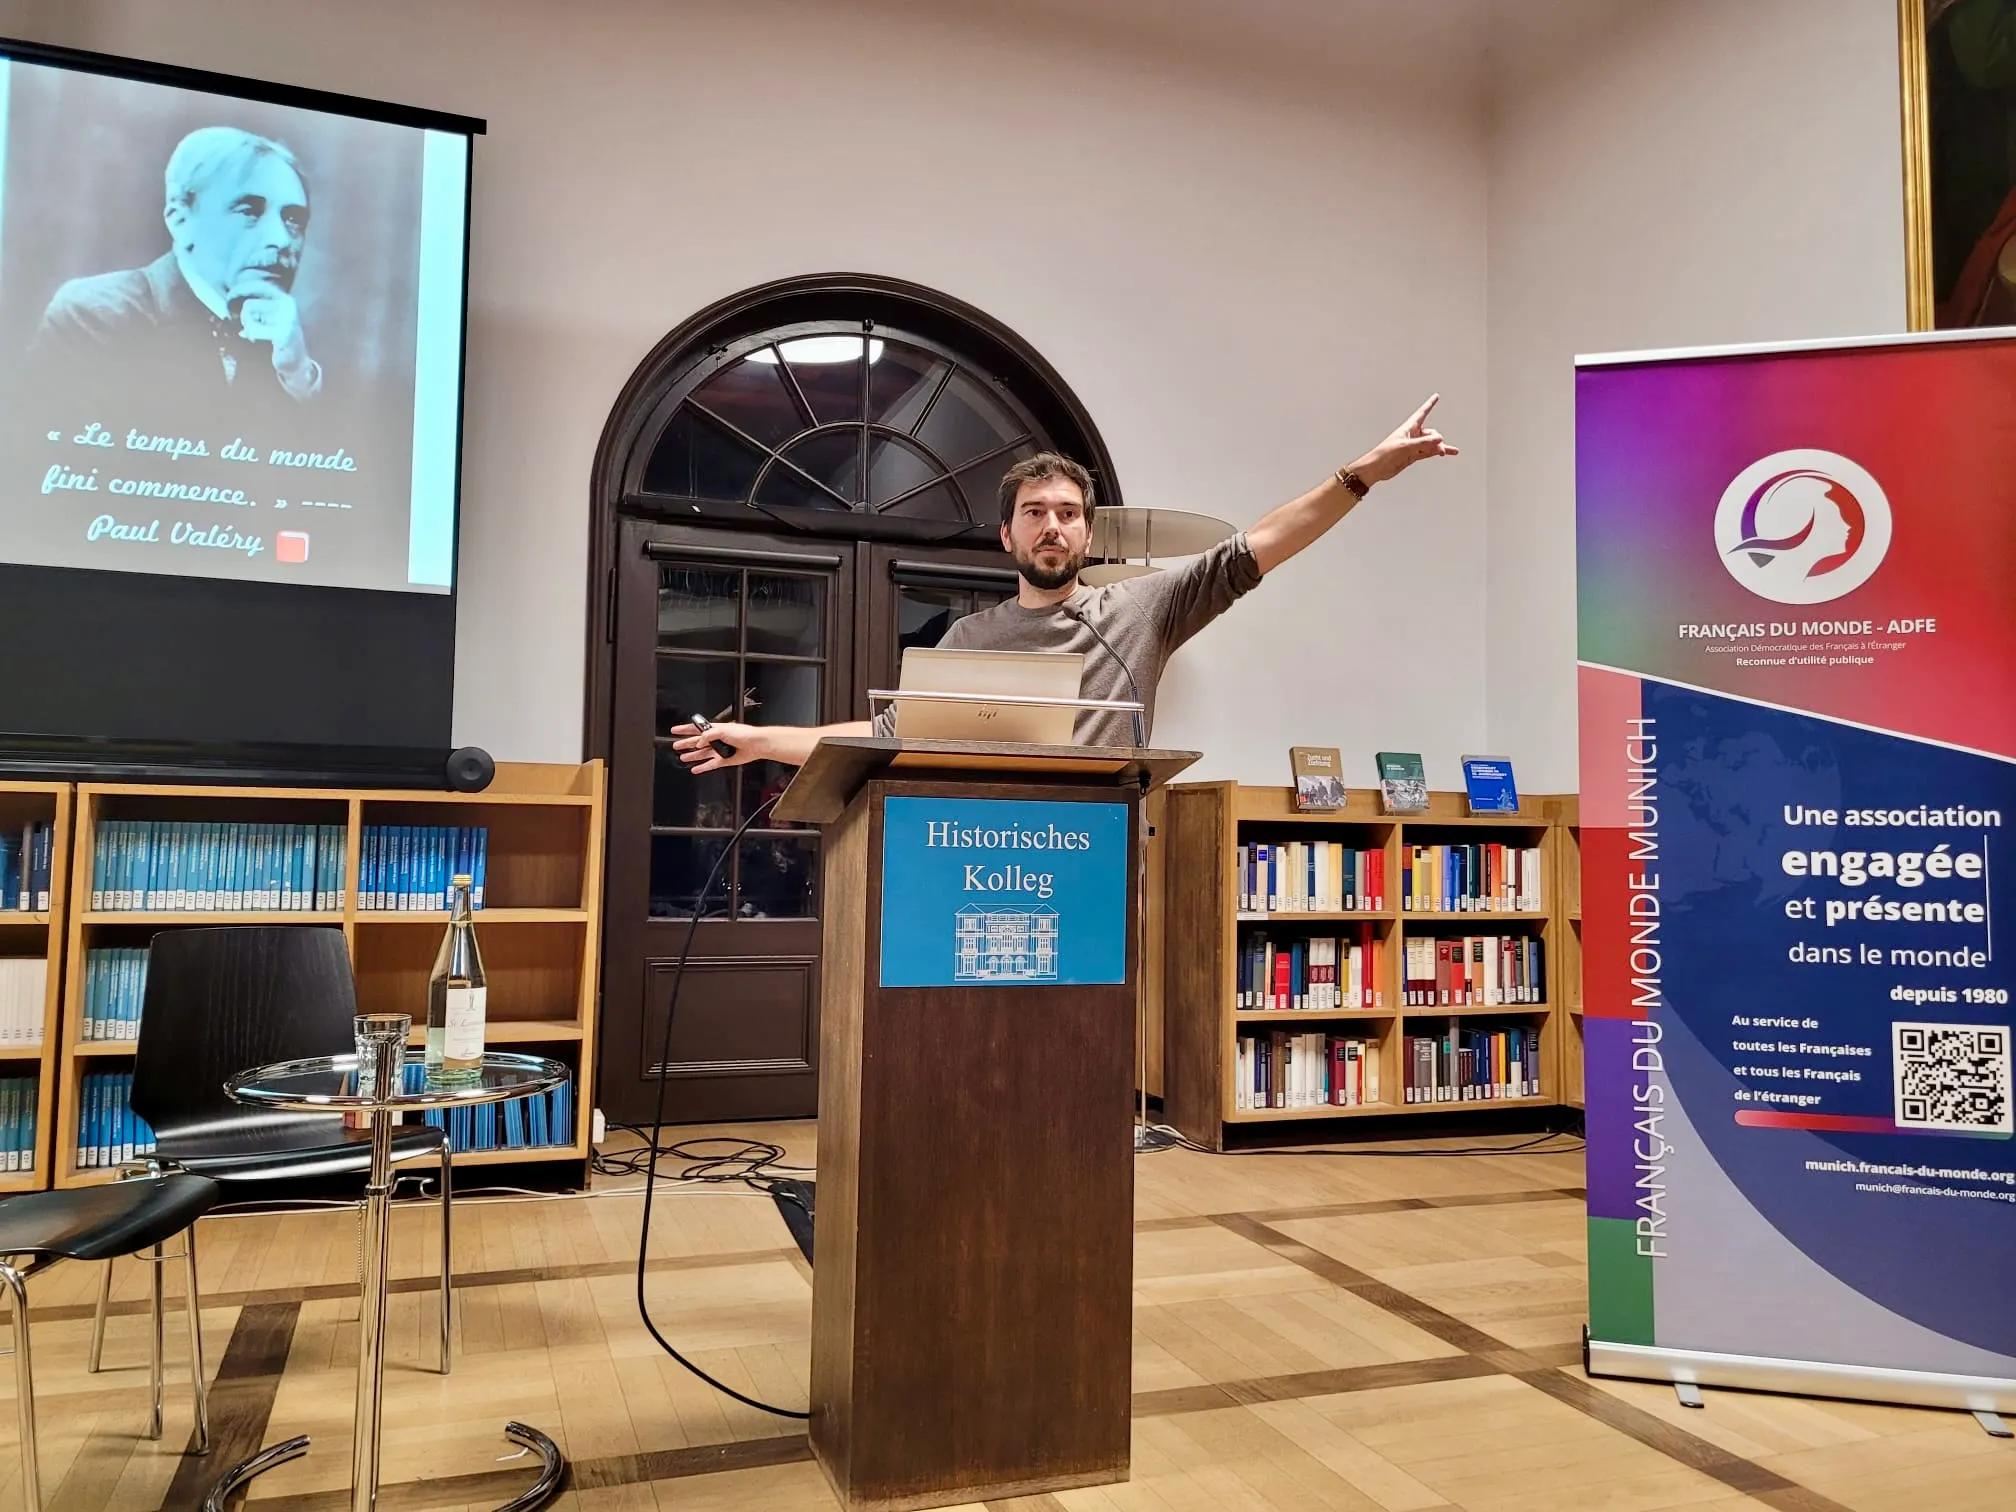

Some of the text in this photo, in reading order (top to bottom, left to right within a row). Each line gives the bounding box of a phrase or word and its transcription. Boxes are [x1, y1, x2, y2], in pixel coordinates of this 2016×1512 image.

[73, 422, 114, 448] Le
[126, 429, 209, 460] temps
[220, 437, 259, 464] du
[269, 448, 357, 471] monde
[41, 464, 98, 494] fini
[109, 475, 257, 507] commence.
[87, 514, 264, 557] Paul Valéry
[1679, 623, 1766, 642] FRANÇAIS
[1770, 622, 1797, 636] DU
[1802, 620, 1873, 636] MONDE
[1887, 619, 1936, 634] ADFE
[1705, 644, 1749, 653] Association
[1751, 643, 1807, 654] Démocratique
[1809, 642, 1824, 651] des
[1826, 642, 1859, 652] Français
[1736, 655, 1874, 666] Reconnue d'utilité publique
[1784, 804, 2001, 827] Une association
[926, 820, 1090, 851] Historisches
[1781, 844, 1983, 887] engagée
[963, 865, 1054, 898] Kolleg
[1785, 895, 1985, 926] et présente
[1788, 942, 1986, 968] dans le monde
[1626, 718, 1674, 1257] FRANÇAIS DU MONDE MUNICH
[1890, 985, 2009, 1005] depuis 1980
[1732, 1015, 1819, 1029] Au service de
[1732, 1041, 1872, 1057] toutes les Françaises
[1733, 1065, 1861, 1082] et tous les Français
[1734, 1089, 1821, 1107] de l'étranger
[1805, 1159, 2015, 1184] munich.francais-du-monde.org
[1855, 1181, 2016, 1203] munich@francais-du-monde.org
